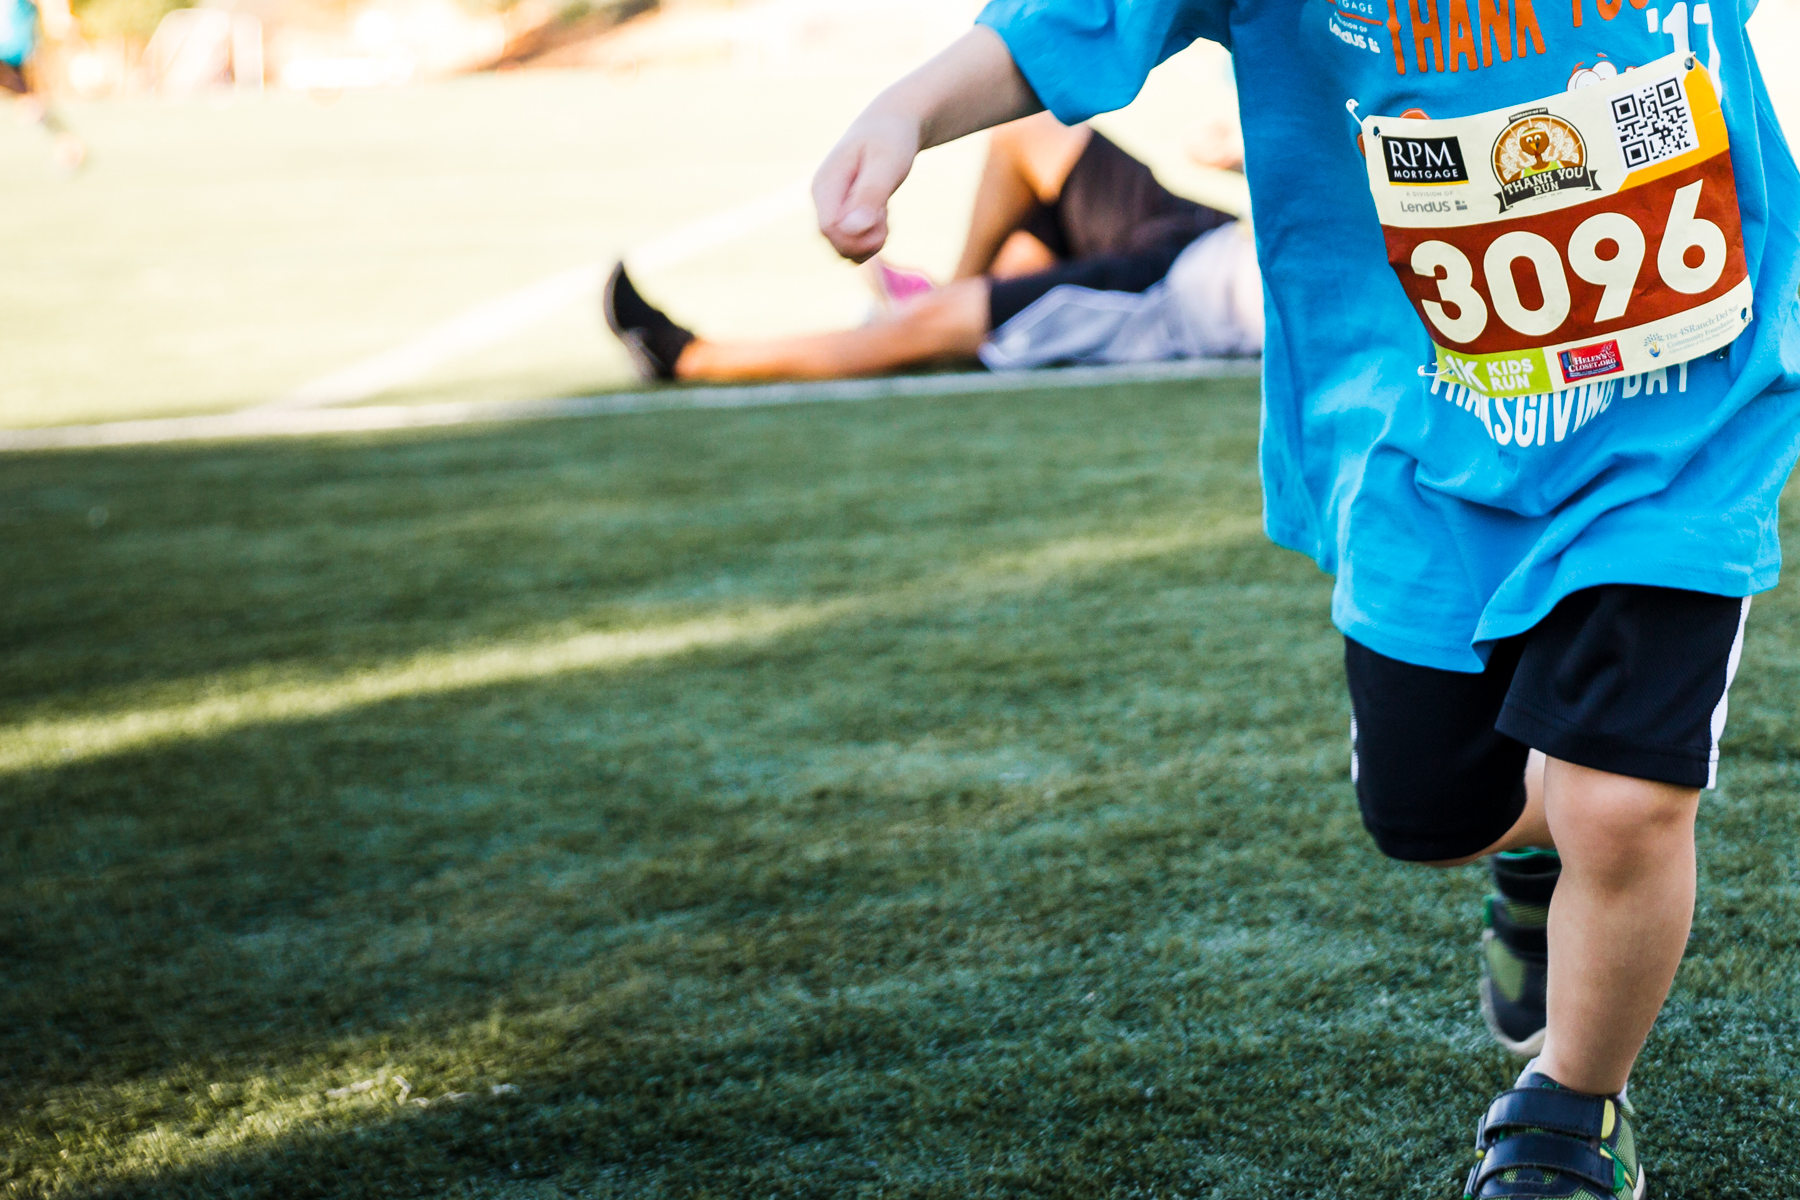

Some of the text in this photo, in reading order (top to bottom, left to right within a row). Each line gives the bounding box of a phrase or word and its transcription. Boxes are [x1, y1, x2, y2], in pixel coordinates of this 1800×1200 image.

[1387, 140, 1456, 168] RPM
[1393, 168, 1459, 179] MORTGAGE
[1504, 166, 1584, 195] THANK YOU
[1533, 181, 1559, 195] RUN
[1400, 201, 1451, 213] LendUS
[1411, 179, 1727, 344] 3096
[1486, 358, 1534, 378] KIDS
[1490, 373, 1531, 392] RUN
